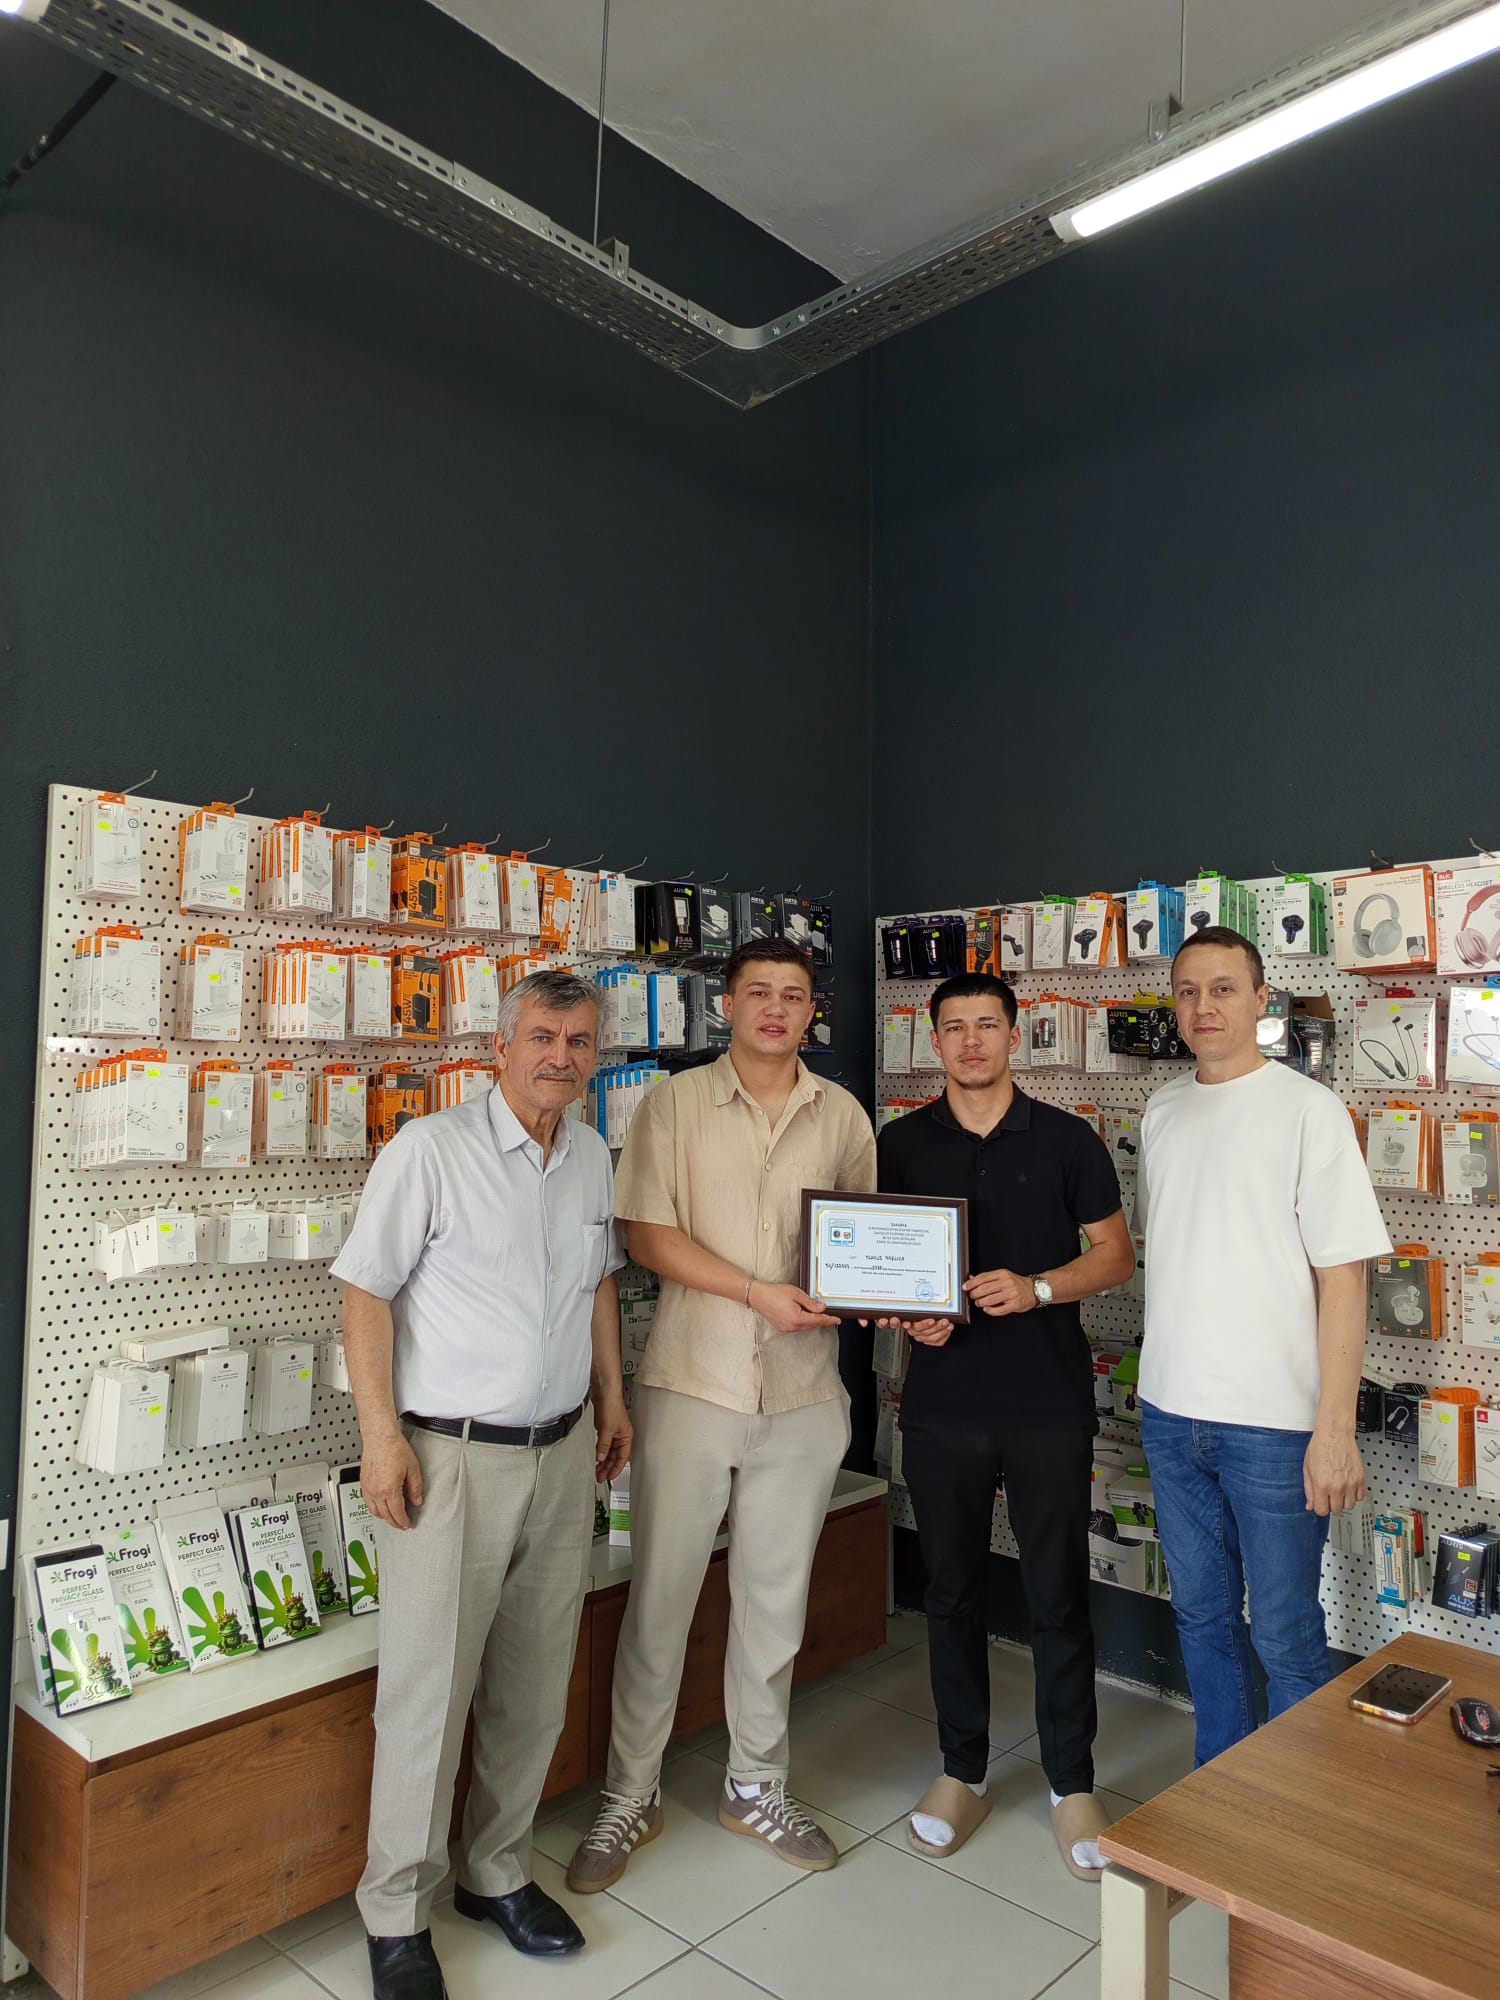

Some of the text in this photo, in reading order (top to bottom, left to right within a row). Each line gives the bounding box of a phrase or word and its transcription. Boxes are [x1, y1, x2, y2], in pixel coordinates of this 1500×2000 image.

[1466, 880, 1492, 888] HEADSET
[296, 1489, 323, 1504] Frogi
[309, 1505, 327, 1514] GLASS
[261, 1511, 290, 1526] Frogi
[189, 1529, 220, 1545] Frogi
[252, 1532, 295, 1547] PRIVACY GLASS
[260, 1529, 284, 1538] PERFECT
[118, 1544, 151, 1561] Frogi
[177, 1545, 225, 1561] PERFECT GLASS
[64, 1564, 98, 1581] Frogi
[108, 1560, 157, 1577] PERFECT GLASS
[62, 1583, 91, 1594] PERFECT
[83, 1587, 104, 1597] GLASS
[1448, 1593, 1476, 1608] AUX
